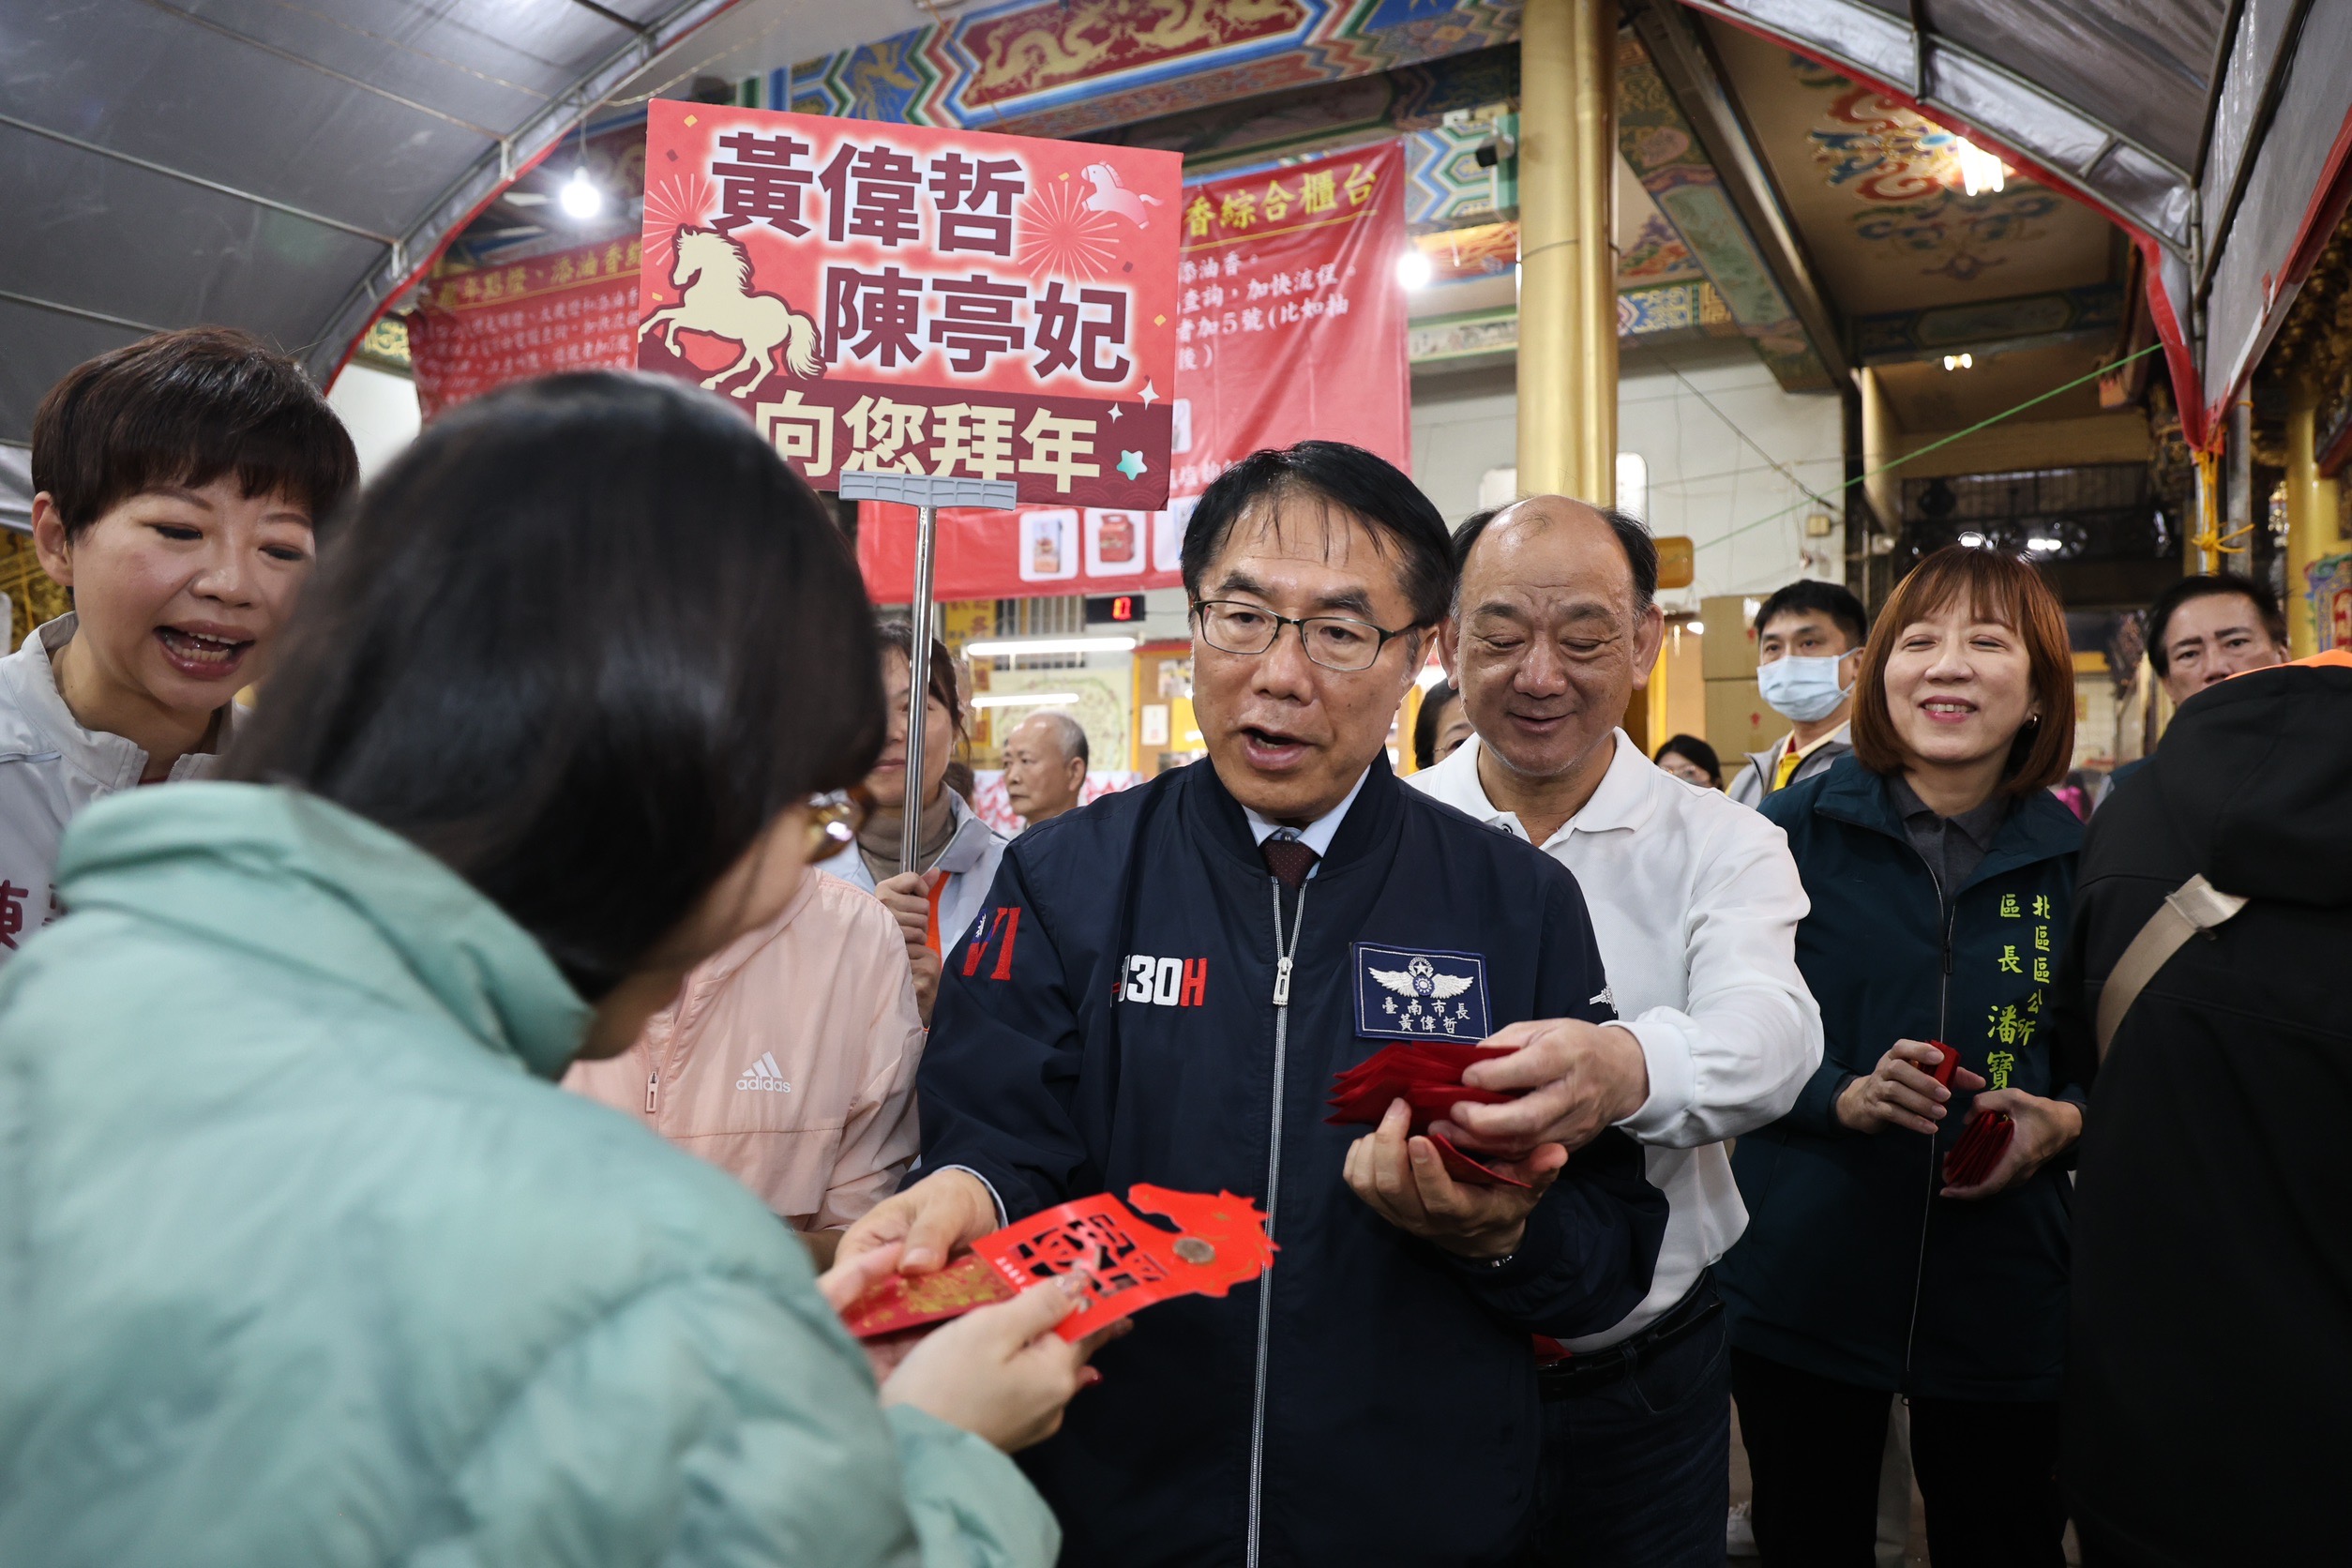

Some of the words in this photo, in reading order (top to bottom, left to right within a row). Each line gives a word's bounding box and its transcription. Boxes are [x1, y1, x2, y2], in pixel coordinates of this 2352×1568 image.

[711, 130, 1027, 258] 黃偉哲
[1184, 165, 1376, 236] 香綜合櫃台
[1177, 263, 1357, 314] 查詢，加快流程。
[822, 265, 1131, 384] 陳亭妃
[755, 389, 1101, 494] 向您拜年
[2017, 894, 2051, 1047] 北區區公所
[1381, 996, 1471, 1020] 臺南市長
[1397, 1013, 1458, 1034] 黃偉哲
[735, 1076, 792, 1094] adidas
